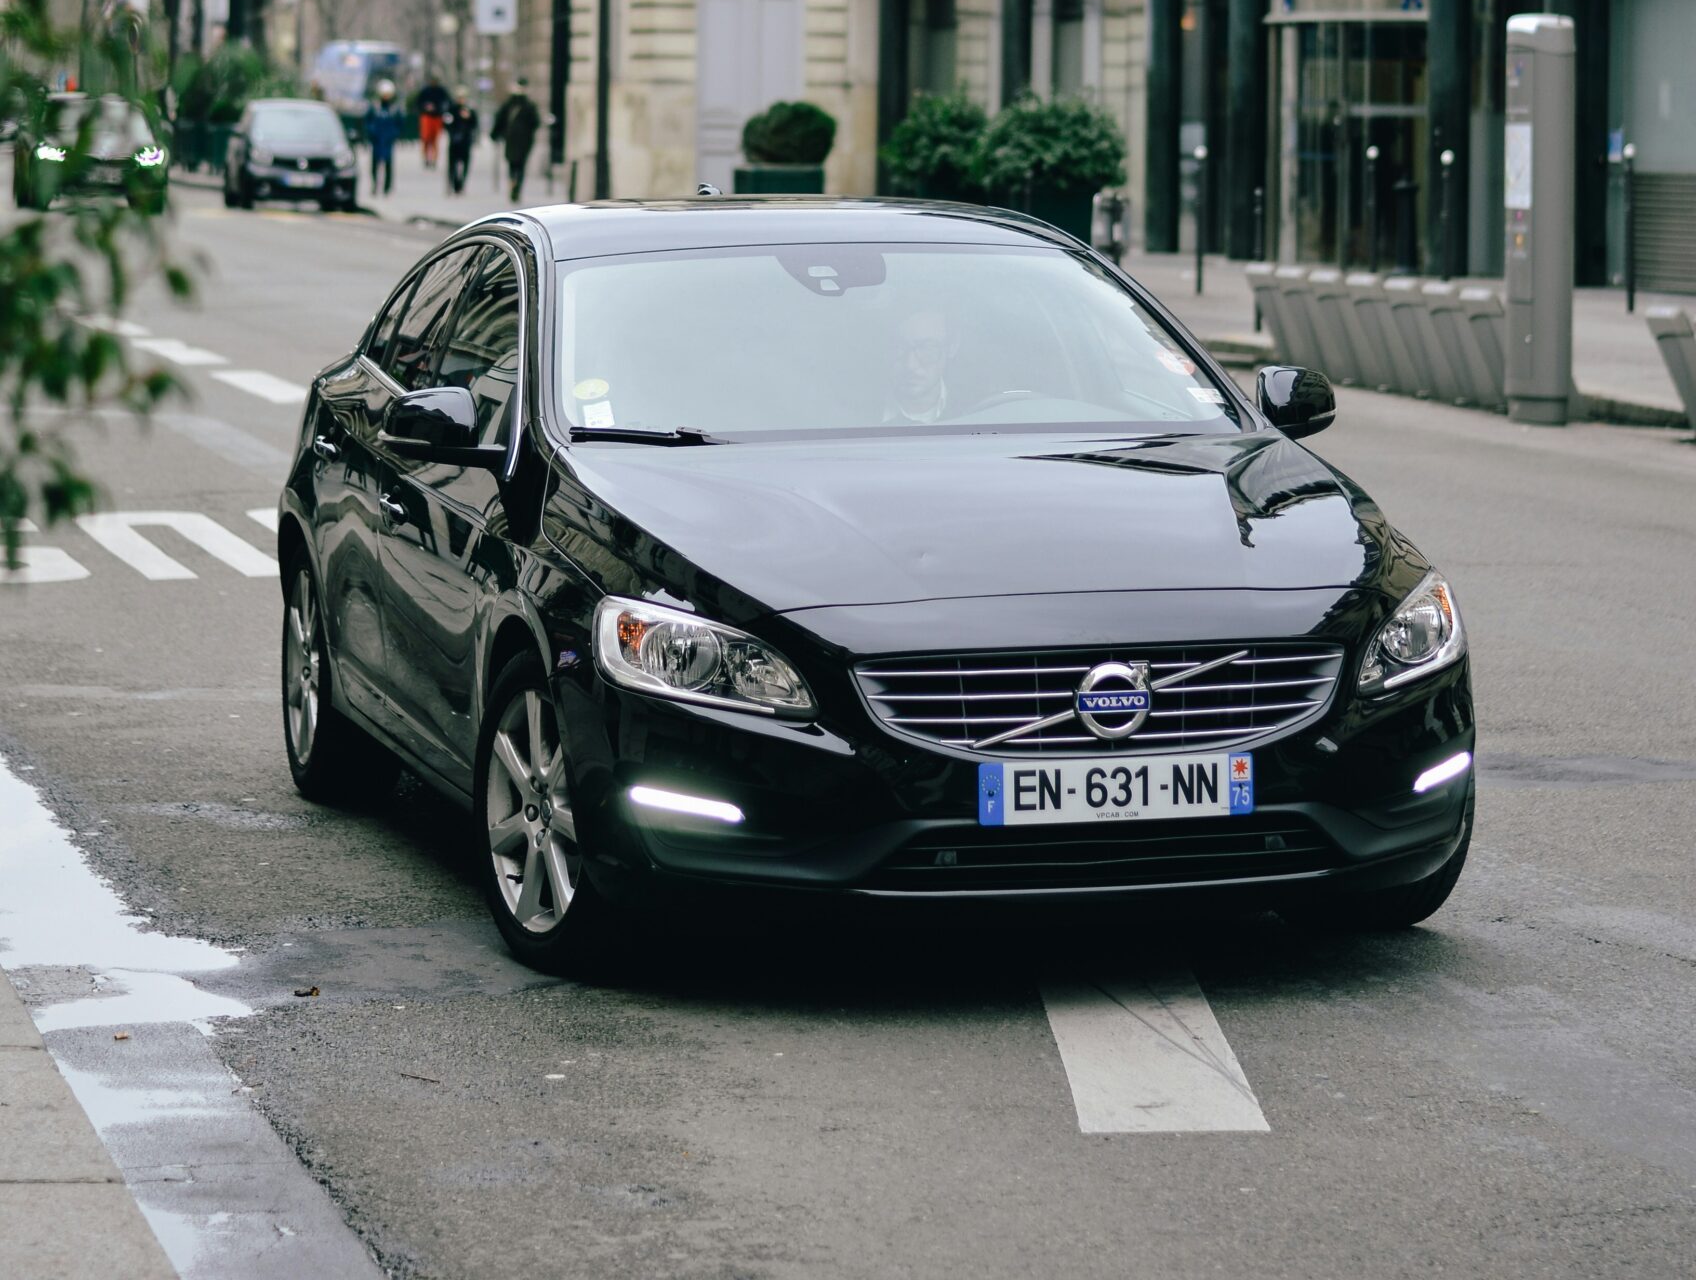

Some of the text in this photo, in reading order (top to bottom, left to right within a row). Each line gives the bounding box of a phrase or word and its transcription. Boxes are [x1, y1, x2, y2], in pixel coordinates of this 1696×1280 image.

[1083, 695, 1145, 708] VOLVO
[1232, 785, 1250, 806] 75
[987, 800, 995, 814] F
